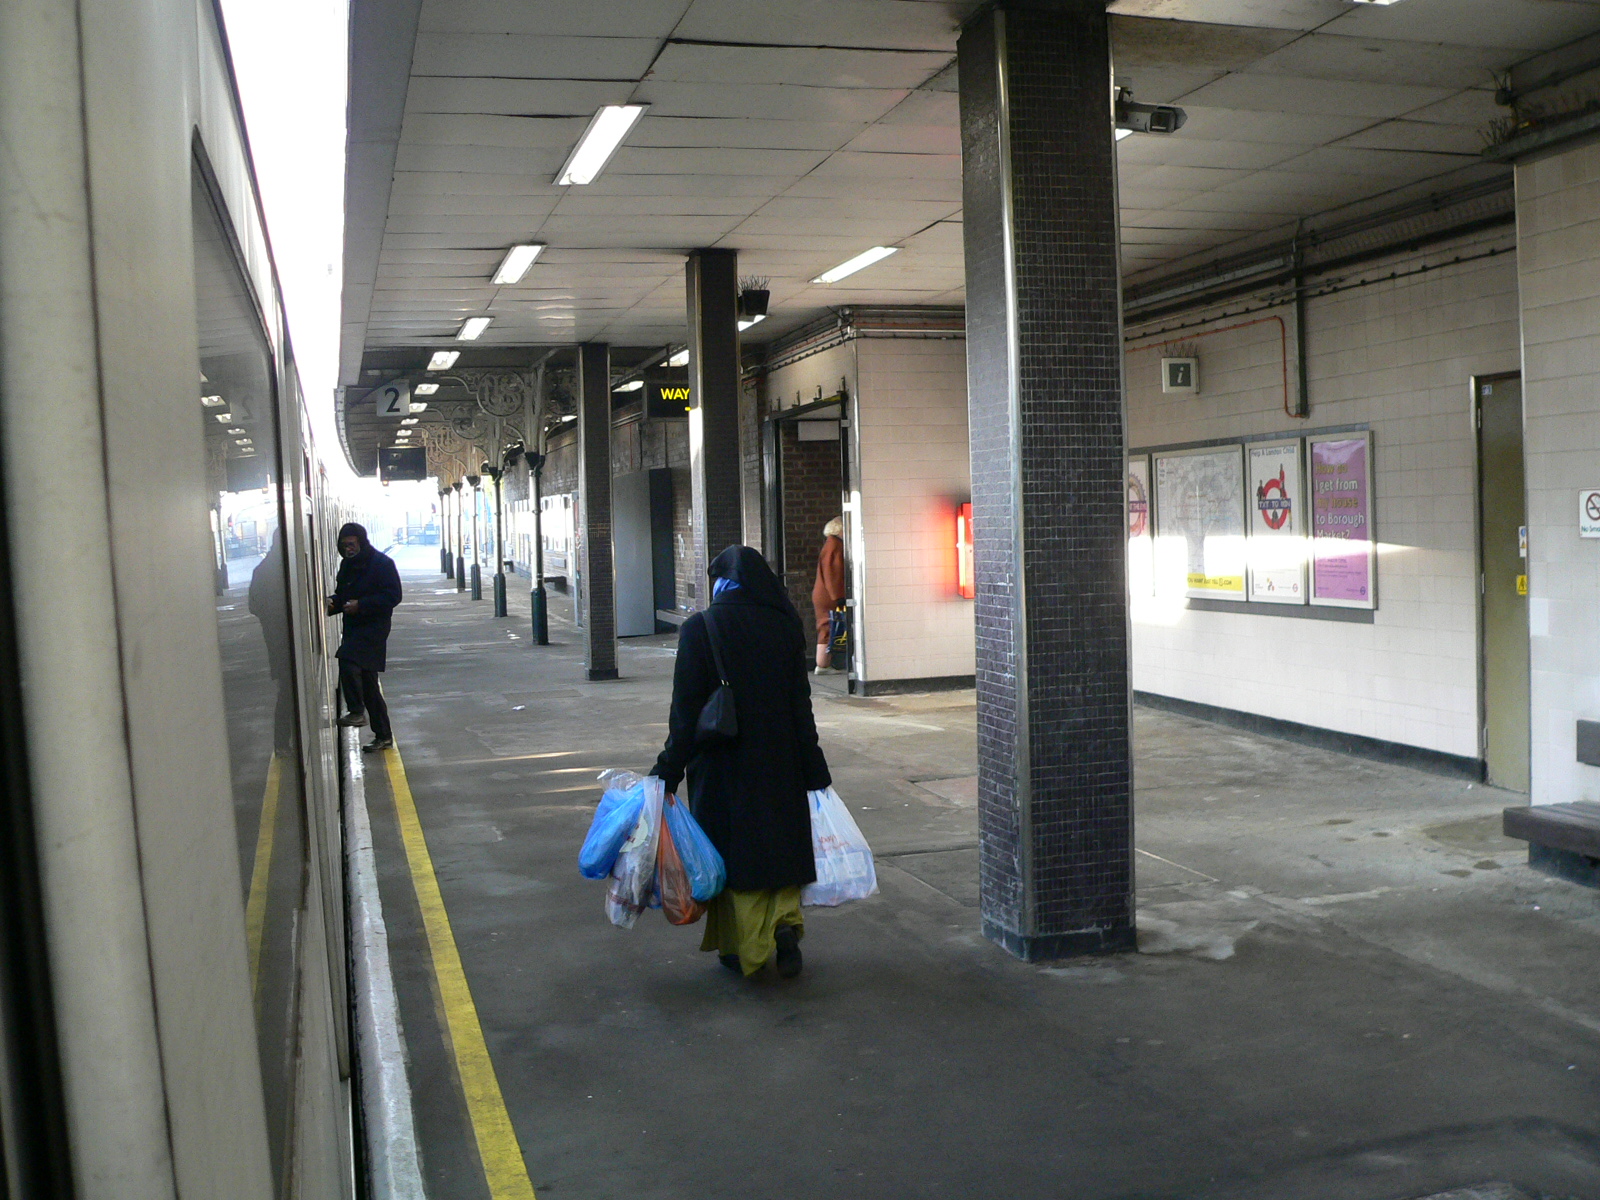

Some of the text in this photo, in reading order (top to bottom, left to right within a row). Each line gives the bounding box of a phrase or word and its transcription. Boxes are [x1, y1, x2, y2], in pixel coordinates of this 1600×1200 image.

[384, 387, 400, 412] 2
[660, 388, 690, 400] WAY
[1316, 462, 1334, 474] How
[1320, 480, 1333, 494] get
[1336, 479, 1358, 491] from
[1331, 495, 1358, 508] house
[1316, 512, 1365, 528] to Borough
[1316, 529, 1350, 540] Market?
[1581, 525, 1588, 533] No
